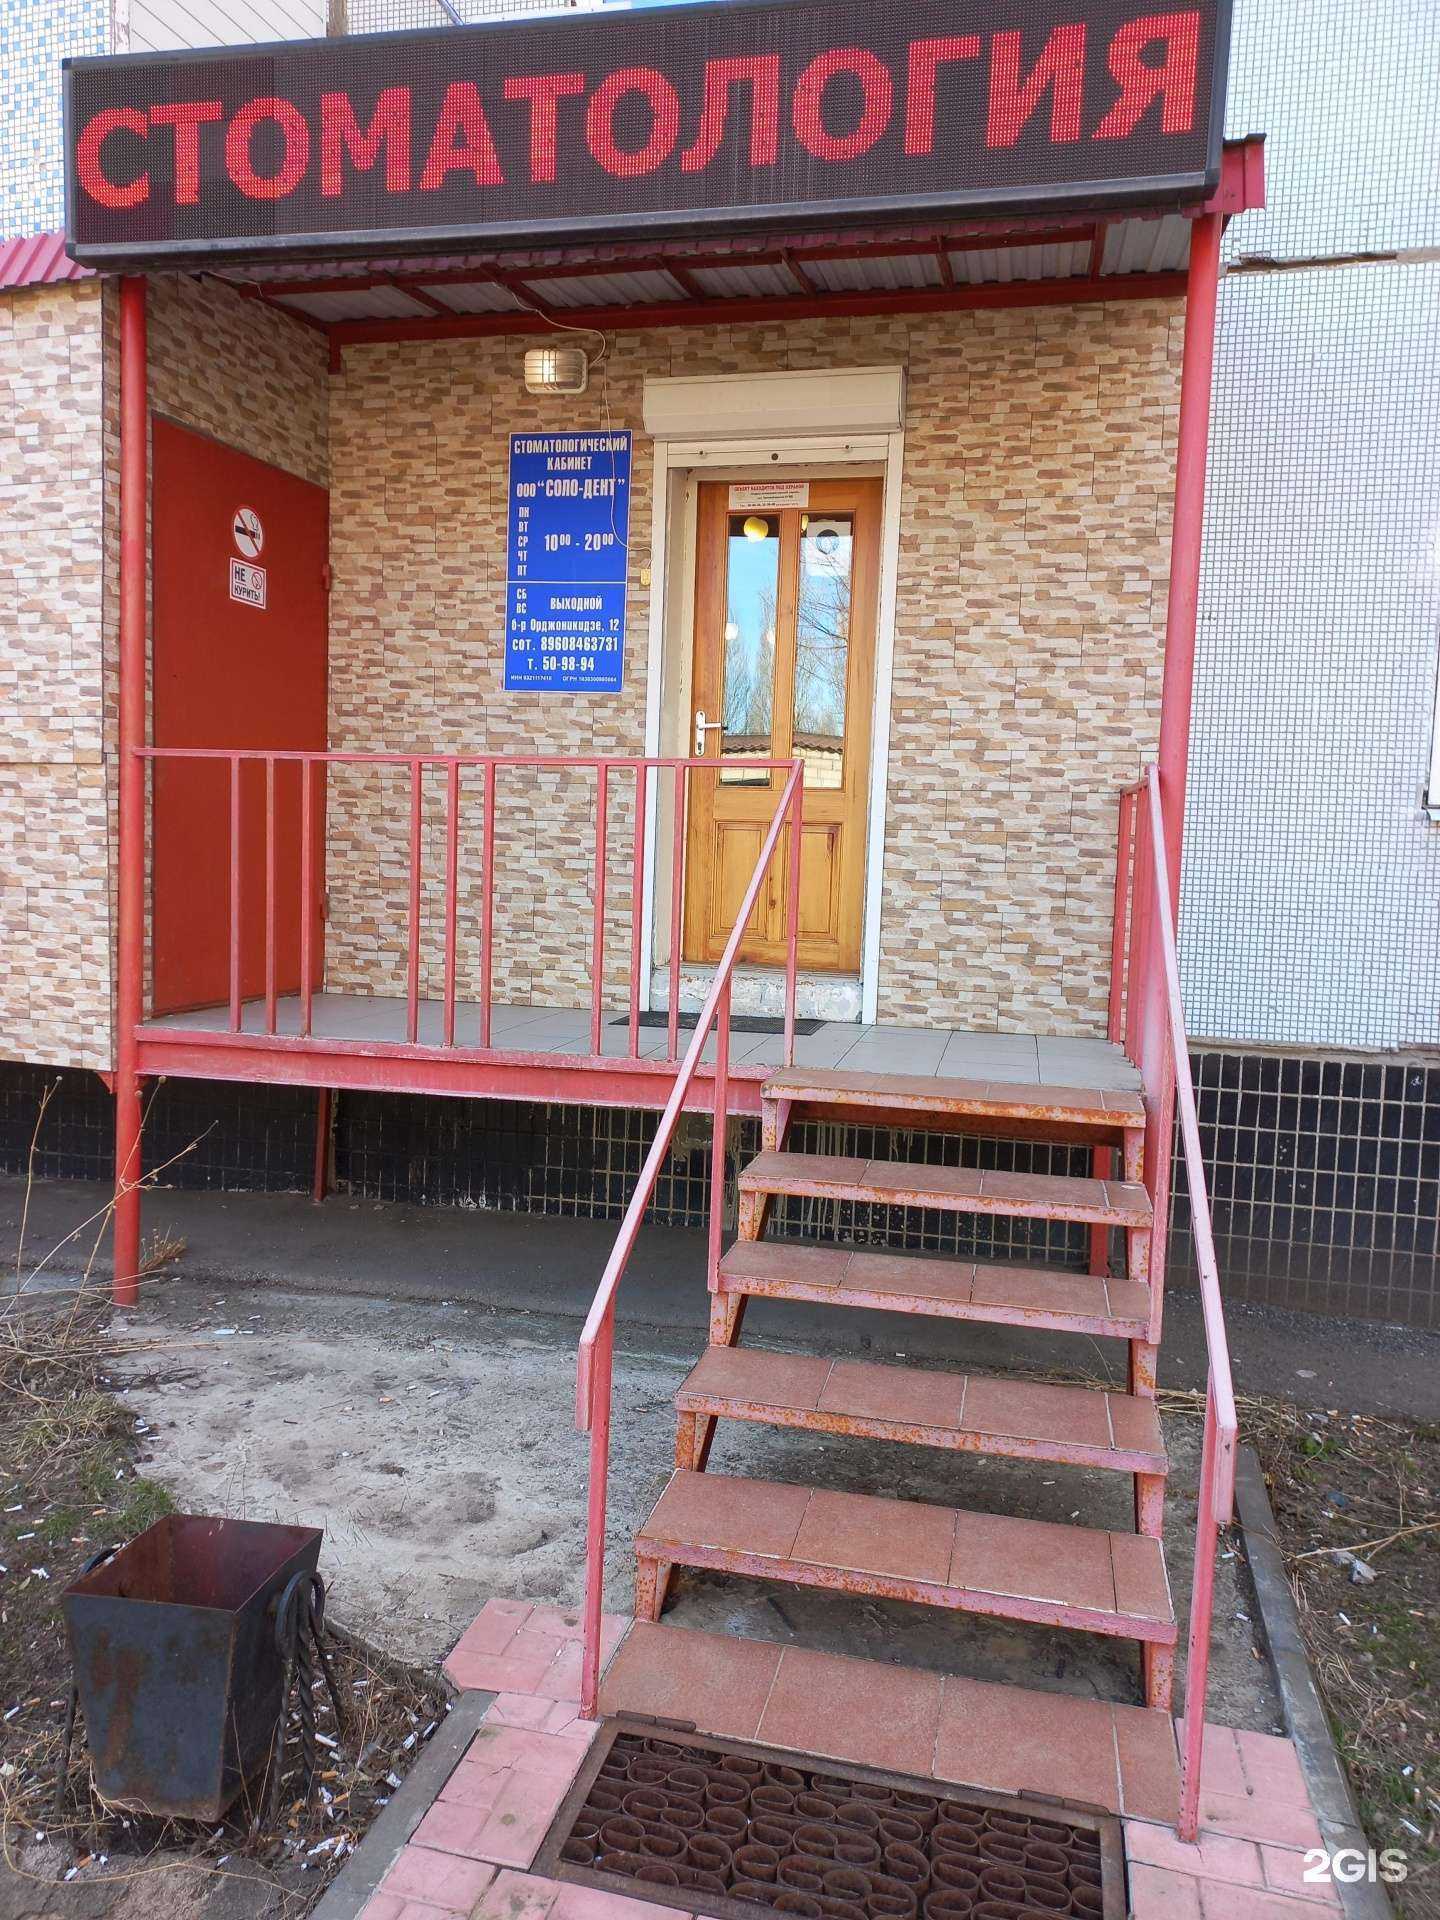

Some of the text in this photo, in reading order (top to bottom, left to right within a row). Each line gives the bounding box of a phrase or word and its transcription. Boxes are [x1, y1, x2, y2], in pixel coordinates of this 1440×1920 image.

[75, 10, 1201, 209] СТОМАТОЛОГИЯ
[514, 436, 628, 454] СТОМАТОЛОГИЧЕСКИЙ
[547, 456, 593, 471] КАБИНЕТ
[516, 483, 537, 498] ООО
[518, 506, 530, 518] ПН
[518, 521, 529, 533] ВТ
[517, 535, 529, 548] СР
[517, 550, 528, 562] ЧТ
[234, 565, 246, 582] НЕ
[517, 564, 528, 577] ПТ
[516, 602, 527, 614] ВС
[550, 595, 603, 612] ВЫХОДНОЙ
[530, 618, 605, 633] Орджоникидзе,
[609, 618, 620, 631] 12
[540, 636, 618, 652] 89608463731
[542, 656, 595, 672] 50-98-94
